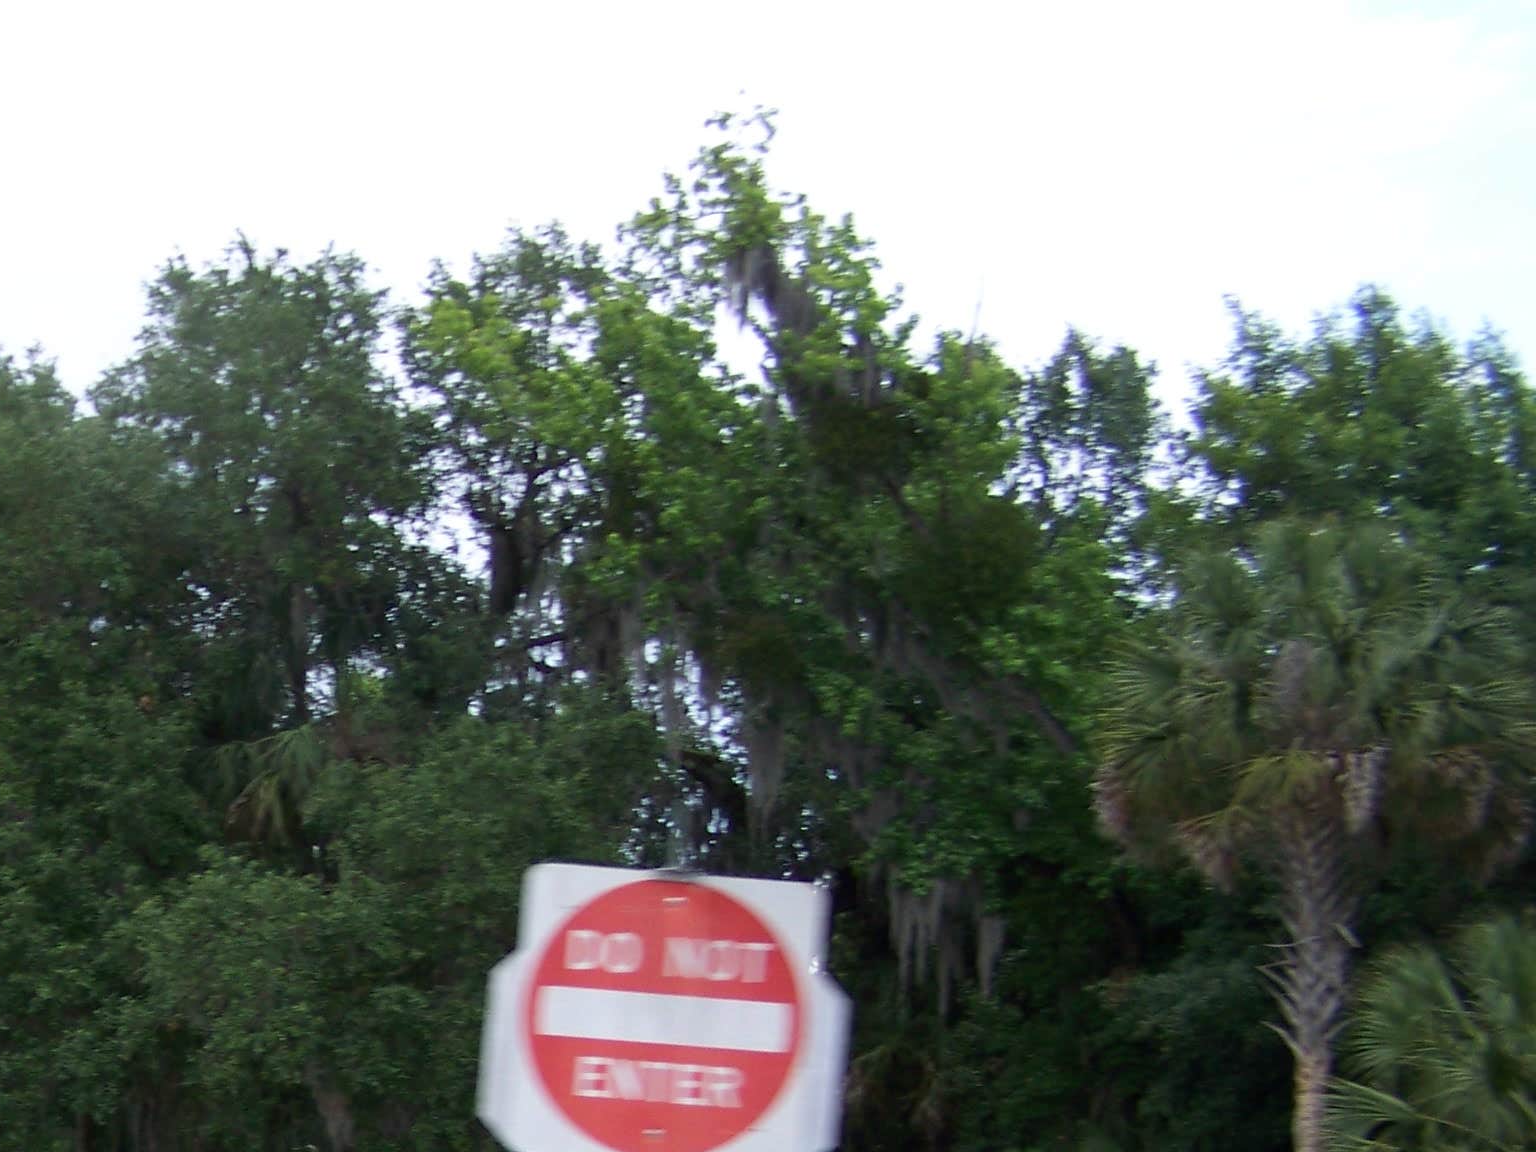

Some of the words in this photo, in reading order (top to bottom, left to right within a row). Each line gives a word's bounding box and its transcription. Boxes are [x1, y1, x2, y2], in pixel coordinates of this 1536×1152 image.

[566, 930, 644, 973] DO
[663, 937, 775, 983] NOT
[572, 1056, 744, 1108] ENTER
